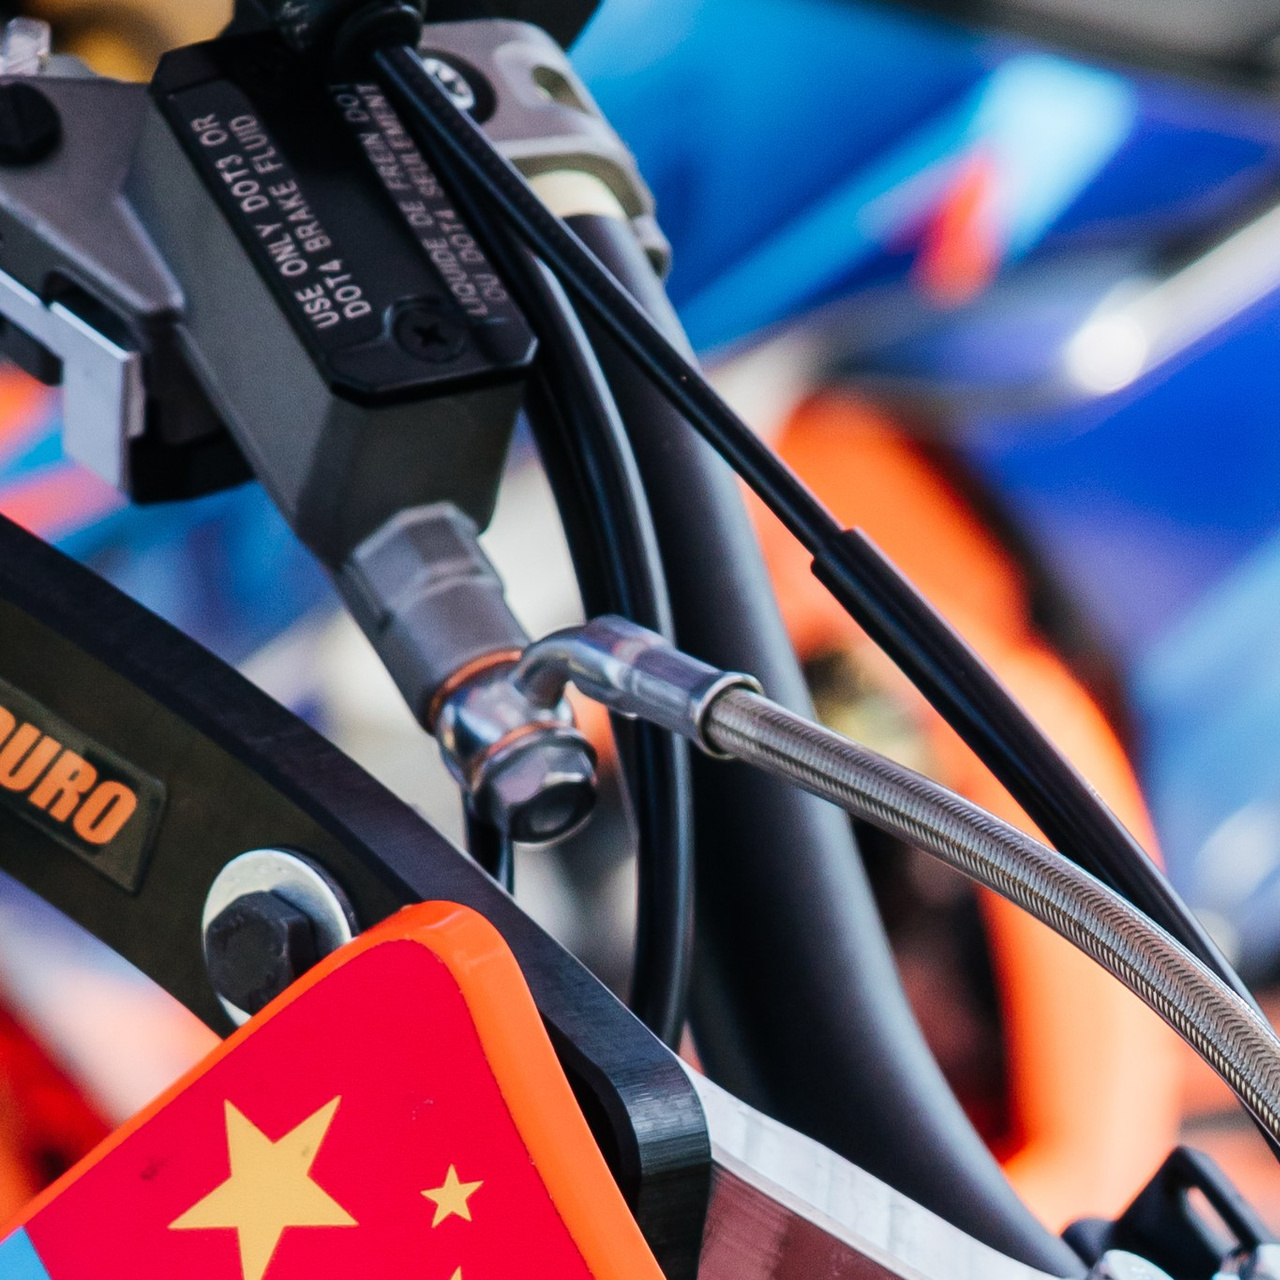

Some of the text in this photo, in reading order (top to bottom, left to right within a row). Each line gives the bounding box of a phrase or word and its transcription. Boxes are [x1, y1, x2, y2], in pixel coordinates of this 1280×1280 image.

[359, 132, 411, 191] FREIN
[191, 113, 339, 330] USE ONLY DOT3 OR
[230, 113, 372, 321] DOT4 BRAKE FLUID
[400, 199, 434, 228] DE
[435, 209, 486, 265] DOT4
[422, 231, 489, 317] LIQUIDE
[475, 270, 508, 303] OU
